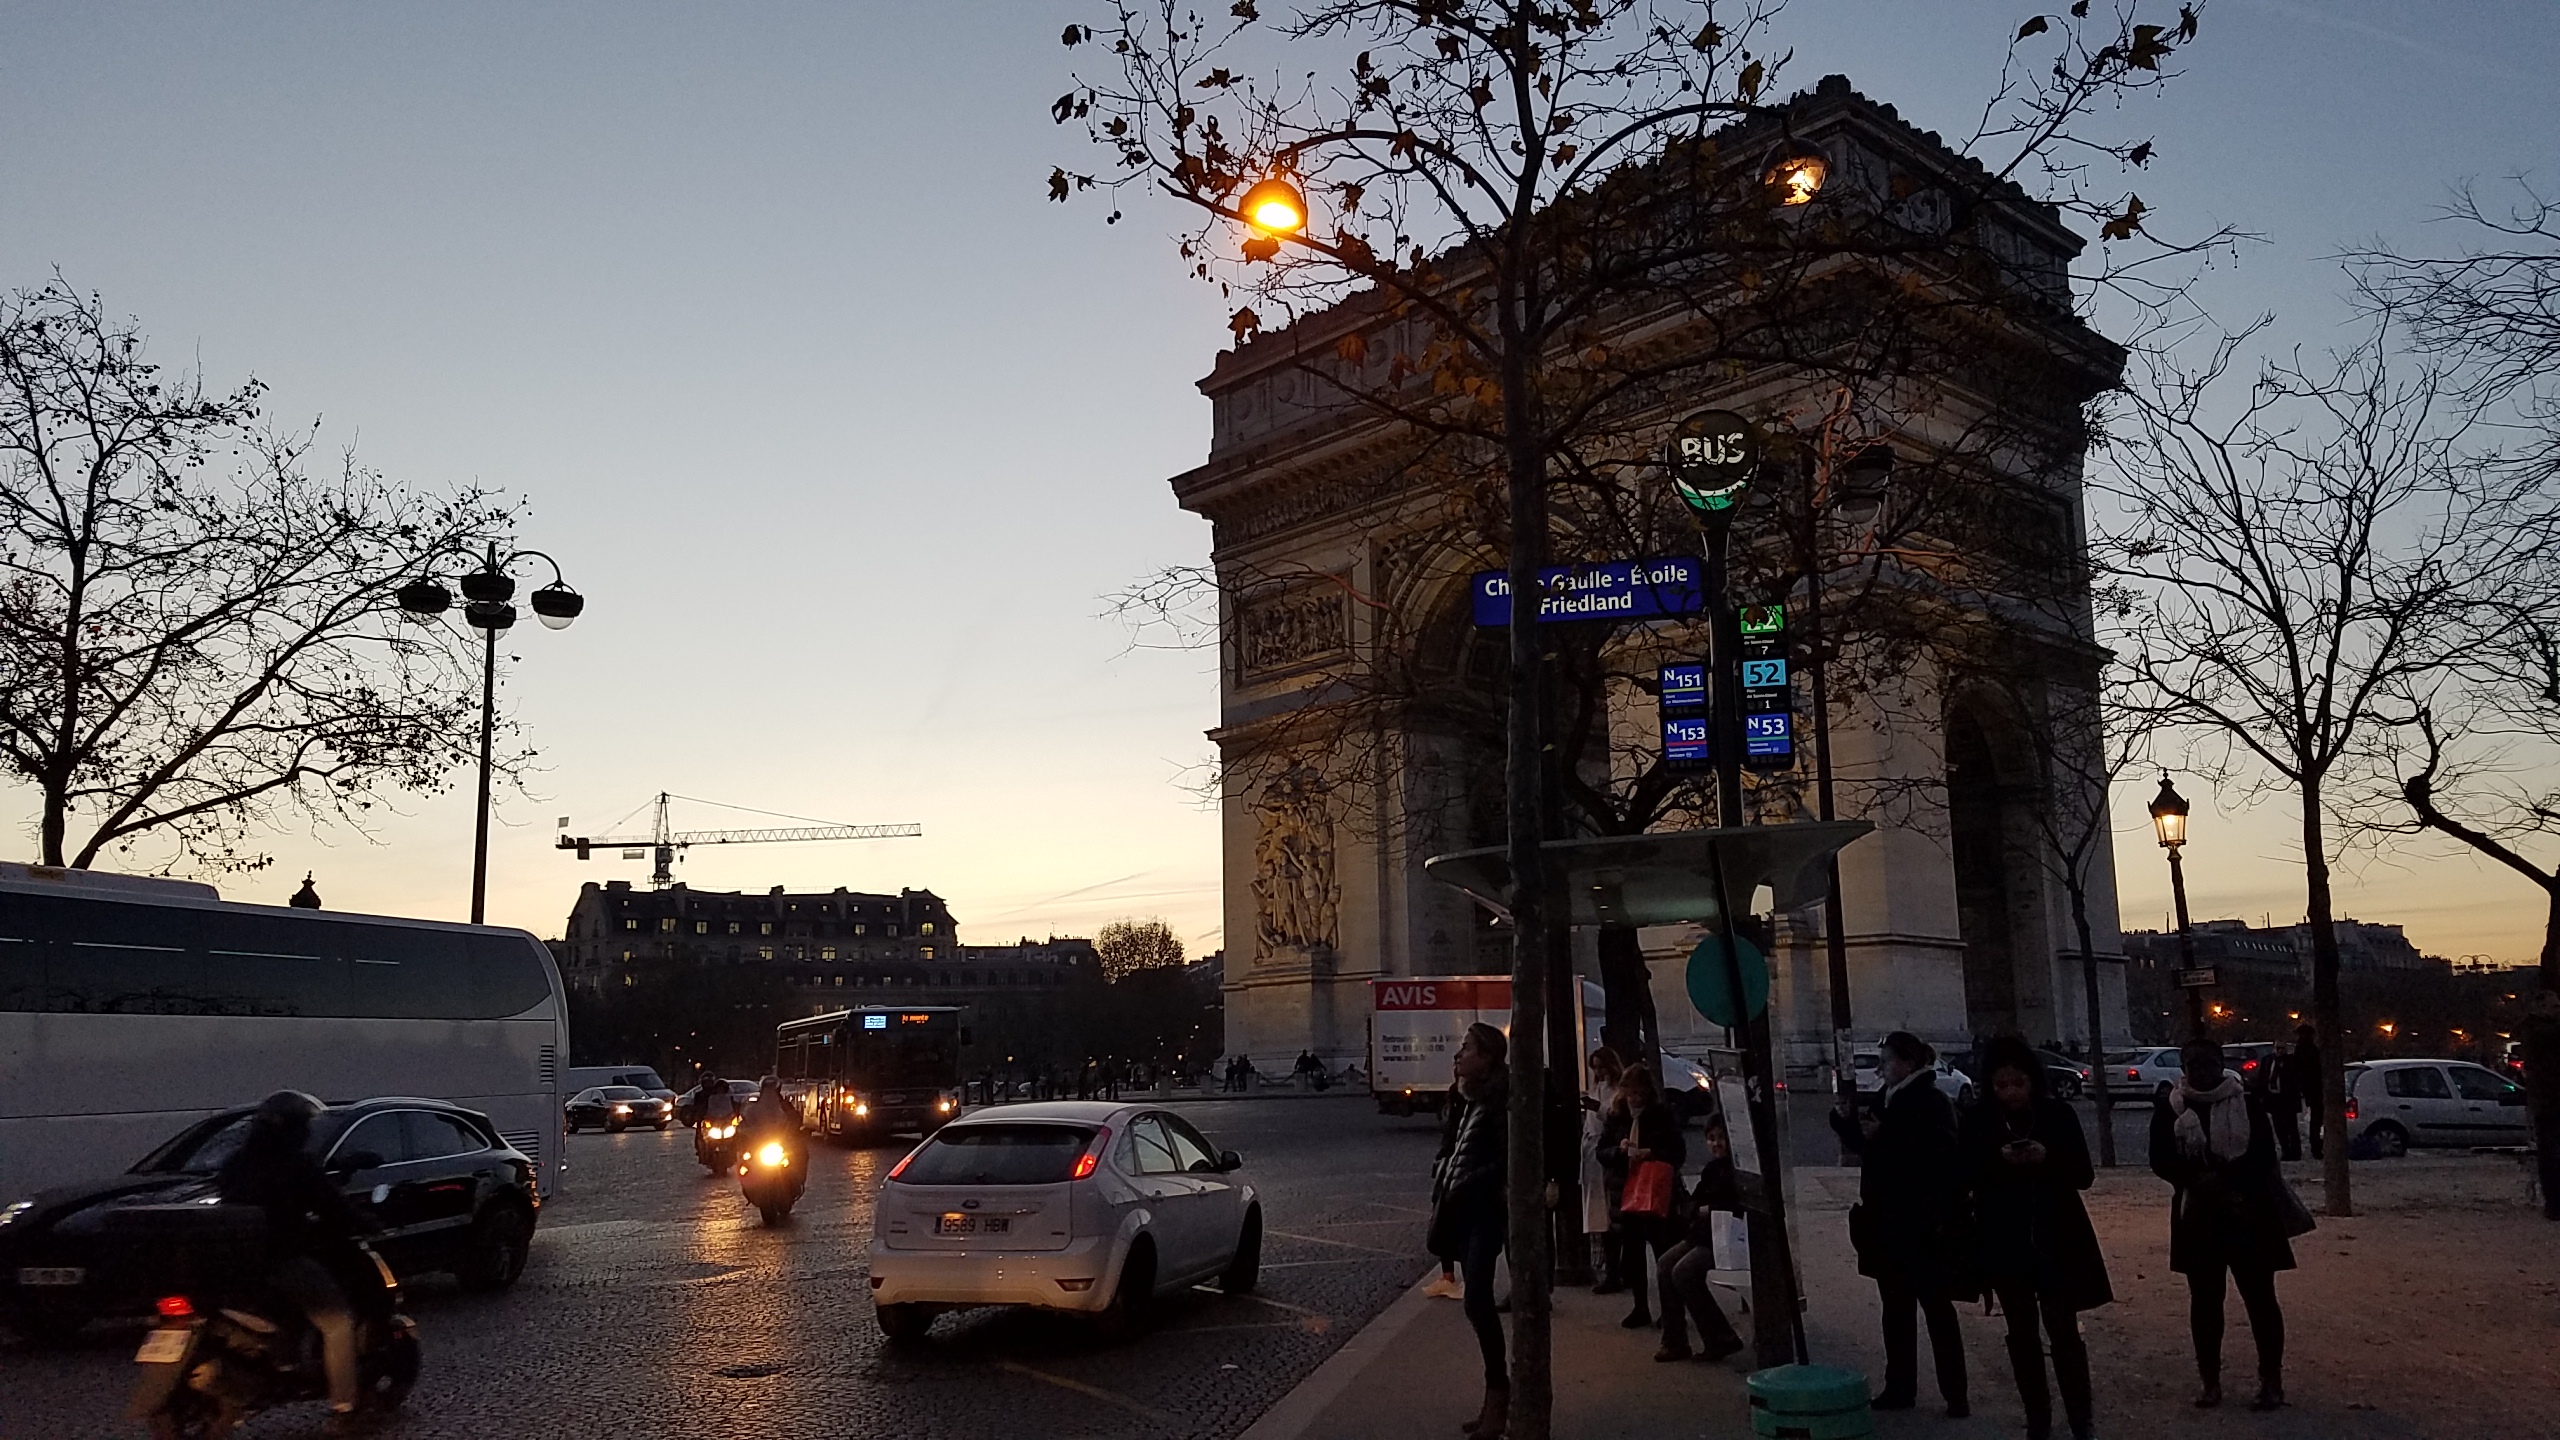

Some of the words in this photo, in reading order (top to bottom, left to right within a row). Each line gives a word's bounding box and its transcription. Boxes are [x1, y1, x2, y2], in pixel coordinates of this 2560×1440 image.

[1681, 432, 1746, 468] BUS
[1540, 590, 1632, 615] Friedland
[1761, 645, 1769, 655] 7
[1664, 669, 1701, 688] N151
[1749, 662, 1780, 684] 52
[1765, 699, 1771, 709] 1
[1667, 722, 1706, 741] N153
[1382, 985, 1437, 1006] AVIS
[944, 1217, 976, 1233] 9589
